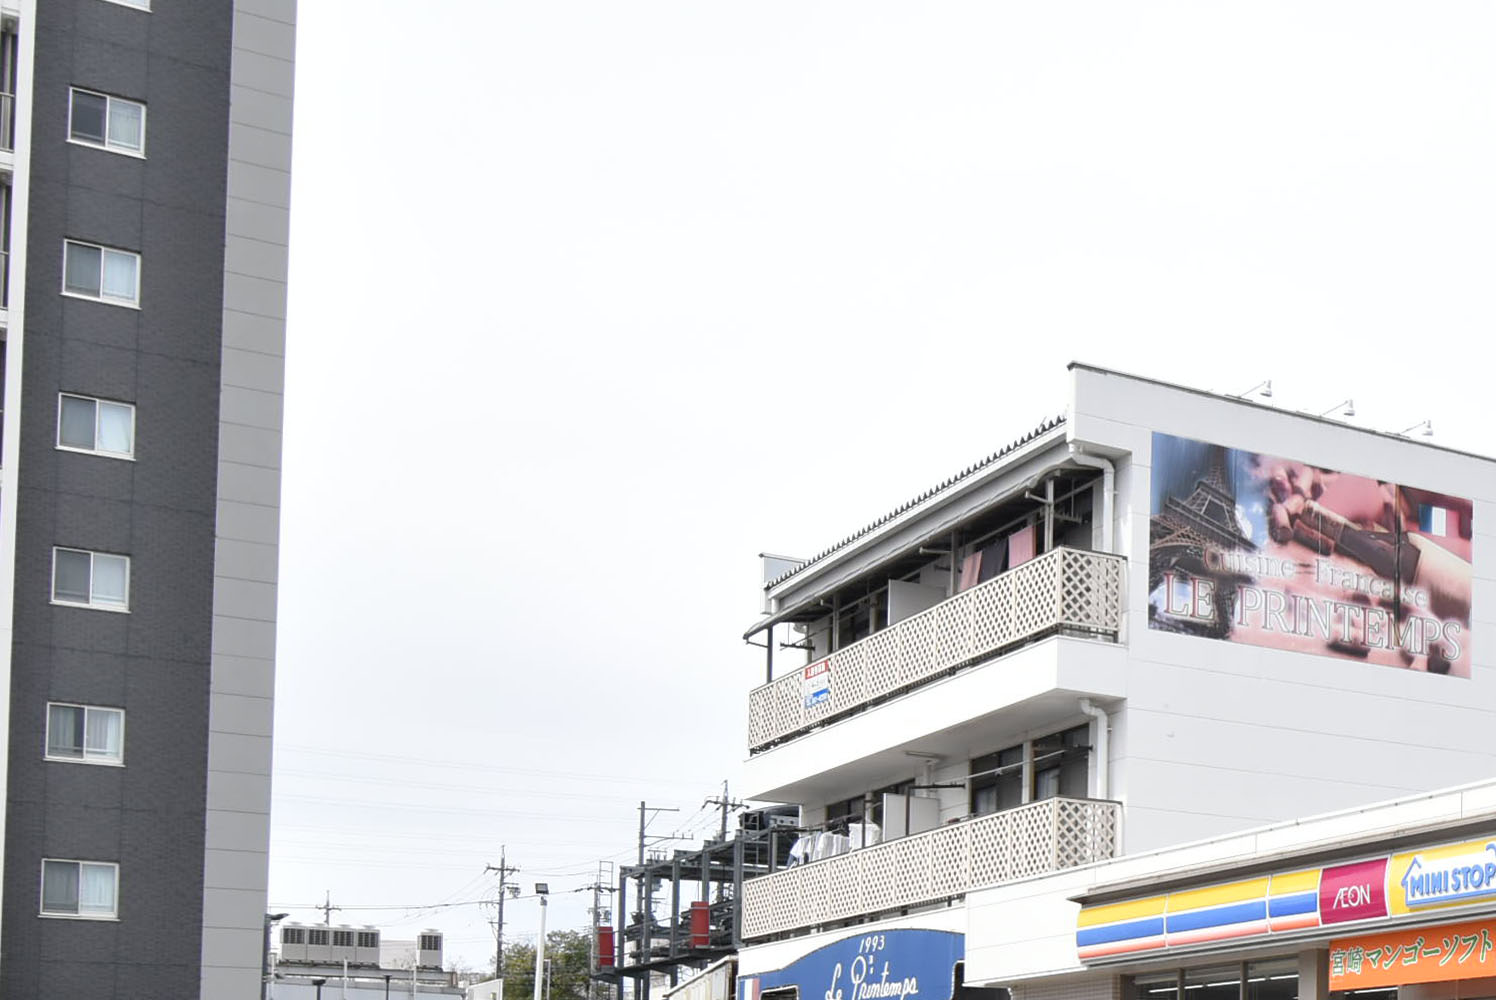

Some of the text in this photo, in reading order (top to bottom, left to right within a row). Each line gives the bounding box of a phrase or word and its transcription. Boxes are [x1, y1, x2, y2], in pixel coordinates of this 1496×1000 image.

[1163, 572, 1463, 662] LE PRINTEMPS
[859, 935, 885, 953] 1993
[1330, 927, 1494, 977] 宮崎マンゴーソフト
